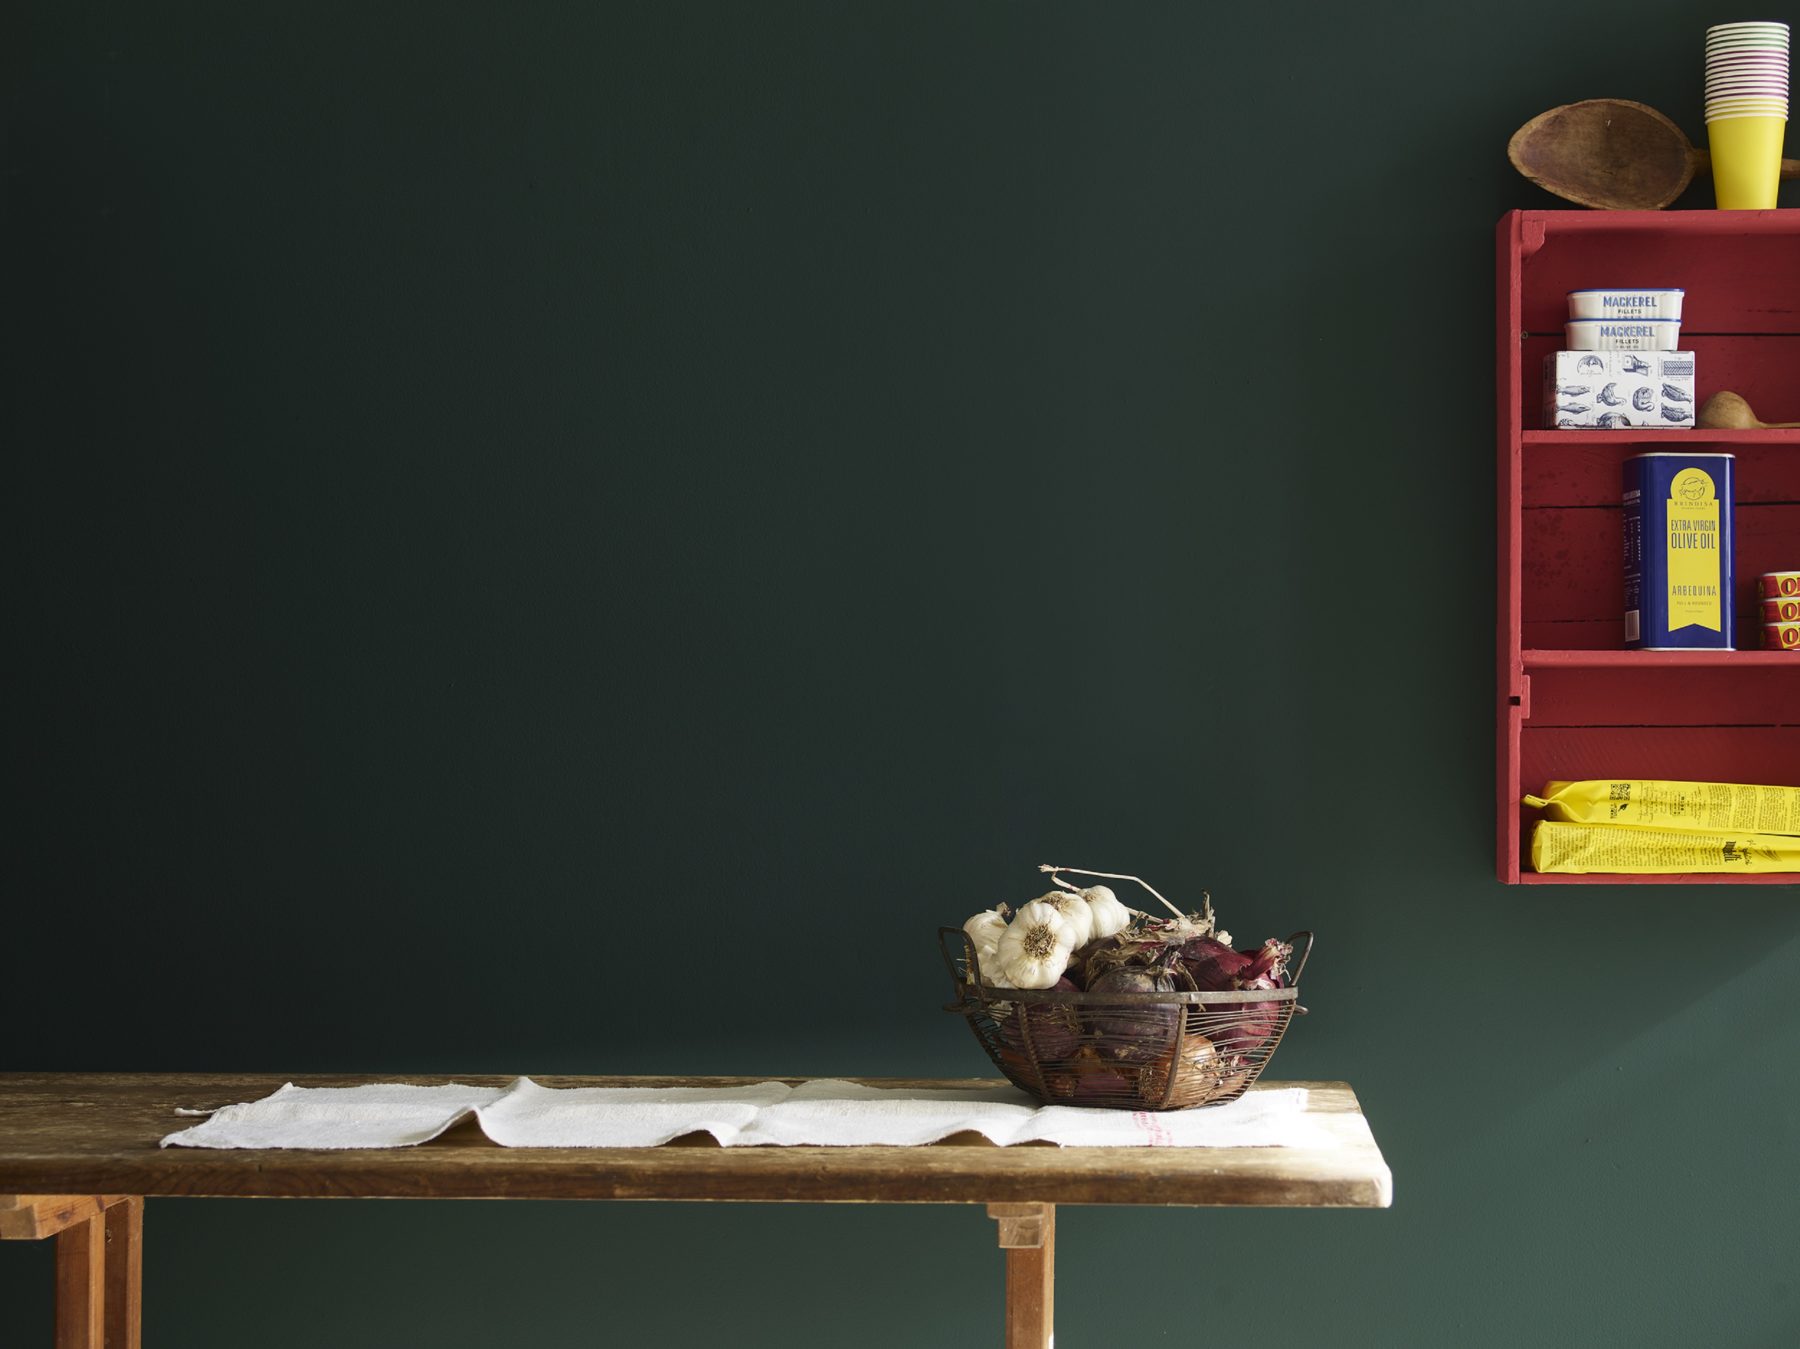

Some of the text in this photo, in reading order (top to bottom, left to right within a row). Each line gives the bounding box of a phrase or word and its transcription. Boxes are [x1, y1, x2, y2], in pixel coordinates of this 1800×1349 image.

[1603, 296, 1657, 307] MACKEREL
[1600, 326, 1655, 337] MACKEREL
[1671, 520, 1716, 532] EXTRA VIRGIN
[1671, 532, 1716, 549] OLIVE OIL
[1672, 585, 1717, 596] ARBEQUINA
